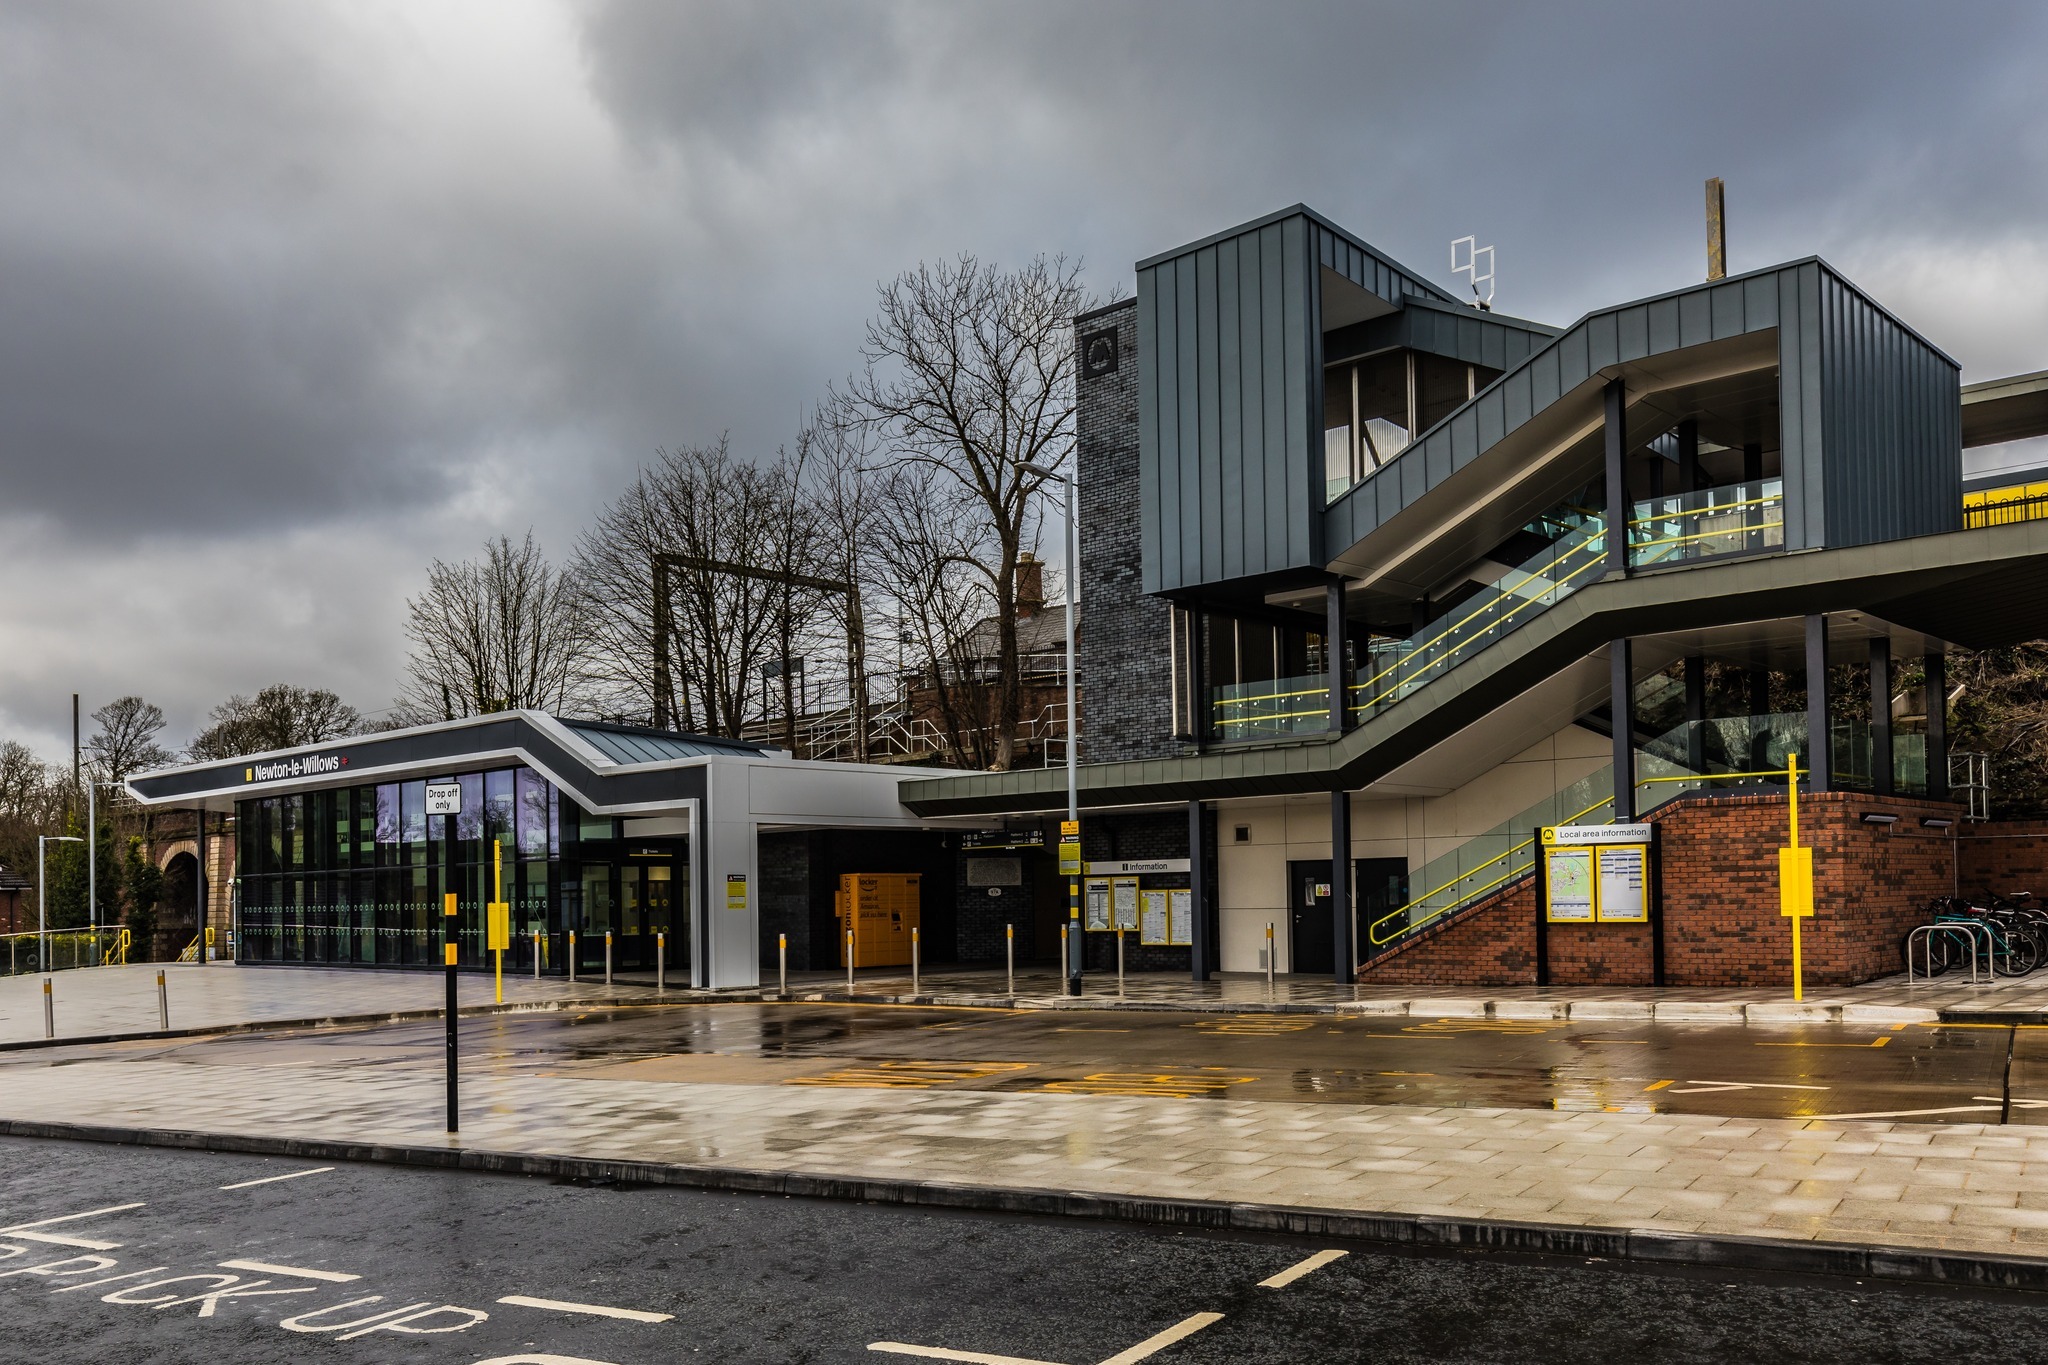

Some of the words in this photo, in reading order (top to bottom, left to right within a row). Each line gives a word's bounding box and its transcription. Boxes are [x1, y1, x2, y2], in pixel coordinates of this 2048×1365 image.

[255, 754, 339, 781] Newton-le-Willows
[429, 789, 446, 799] Drop
[447, 788, 458, 797] off
[435, 800, 451, 810] only
[1601, 829, 1647, 837] information
[1129, 862, 1168, 871] Information
[280, 1295, 489, 1341] UP
